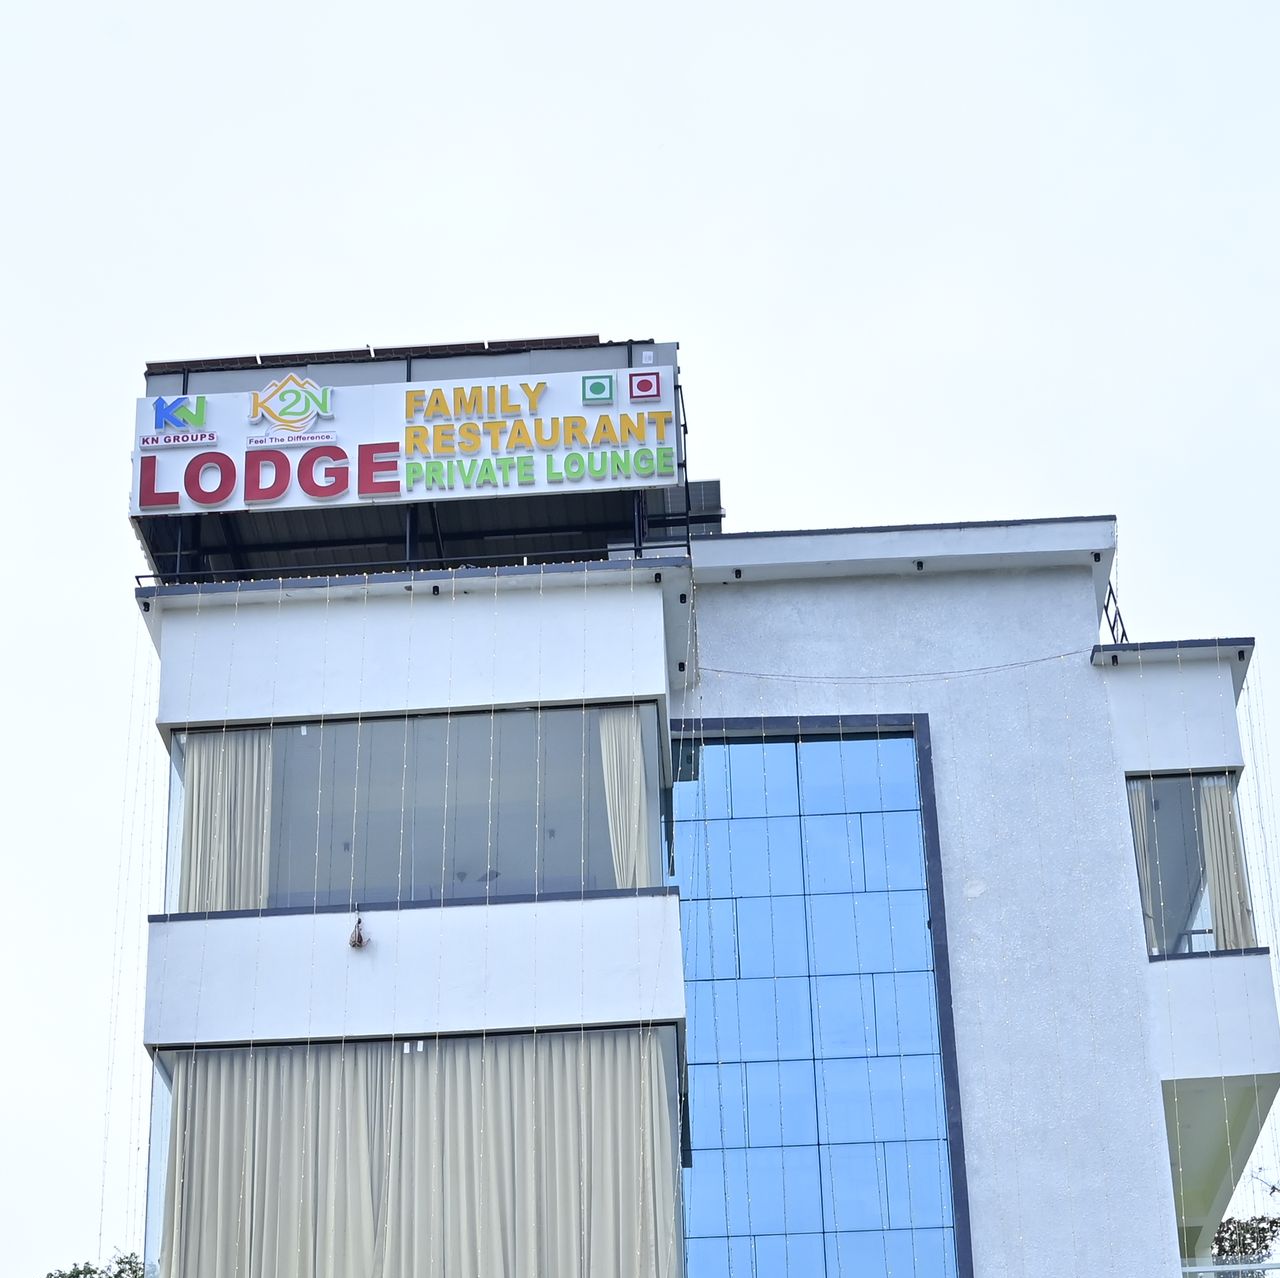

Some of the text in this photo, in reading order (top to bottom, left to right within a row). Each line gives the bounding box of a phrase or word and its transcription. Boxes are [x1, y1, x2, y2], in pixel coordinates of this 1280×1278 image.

[405, 382, 546, 422] FAMILY
[142, 433, 215, 445] KN GROUPS
[405, 411, 673, 457] RESTAURANT
[139, 442, 401, 508] LODGE
[405, 447, 675, 491] PRIVATE LOUNGE
